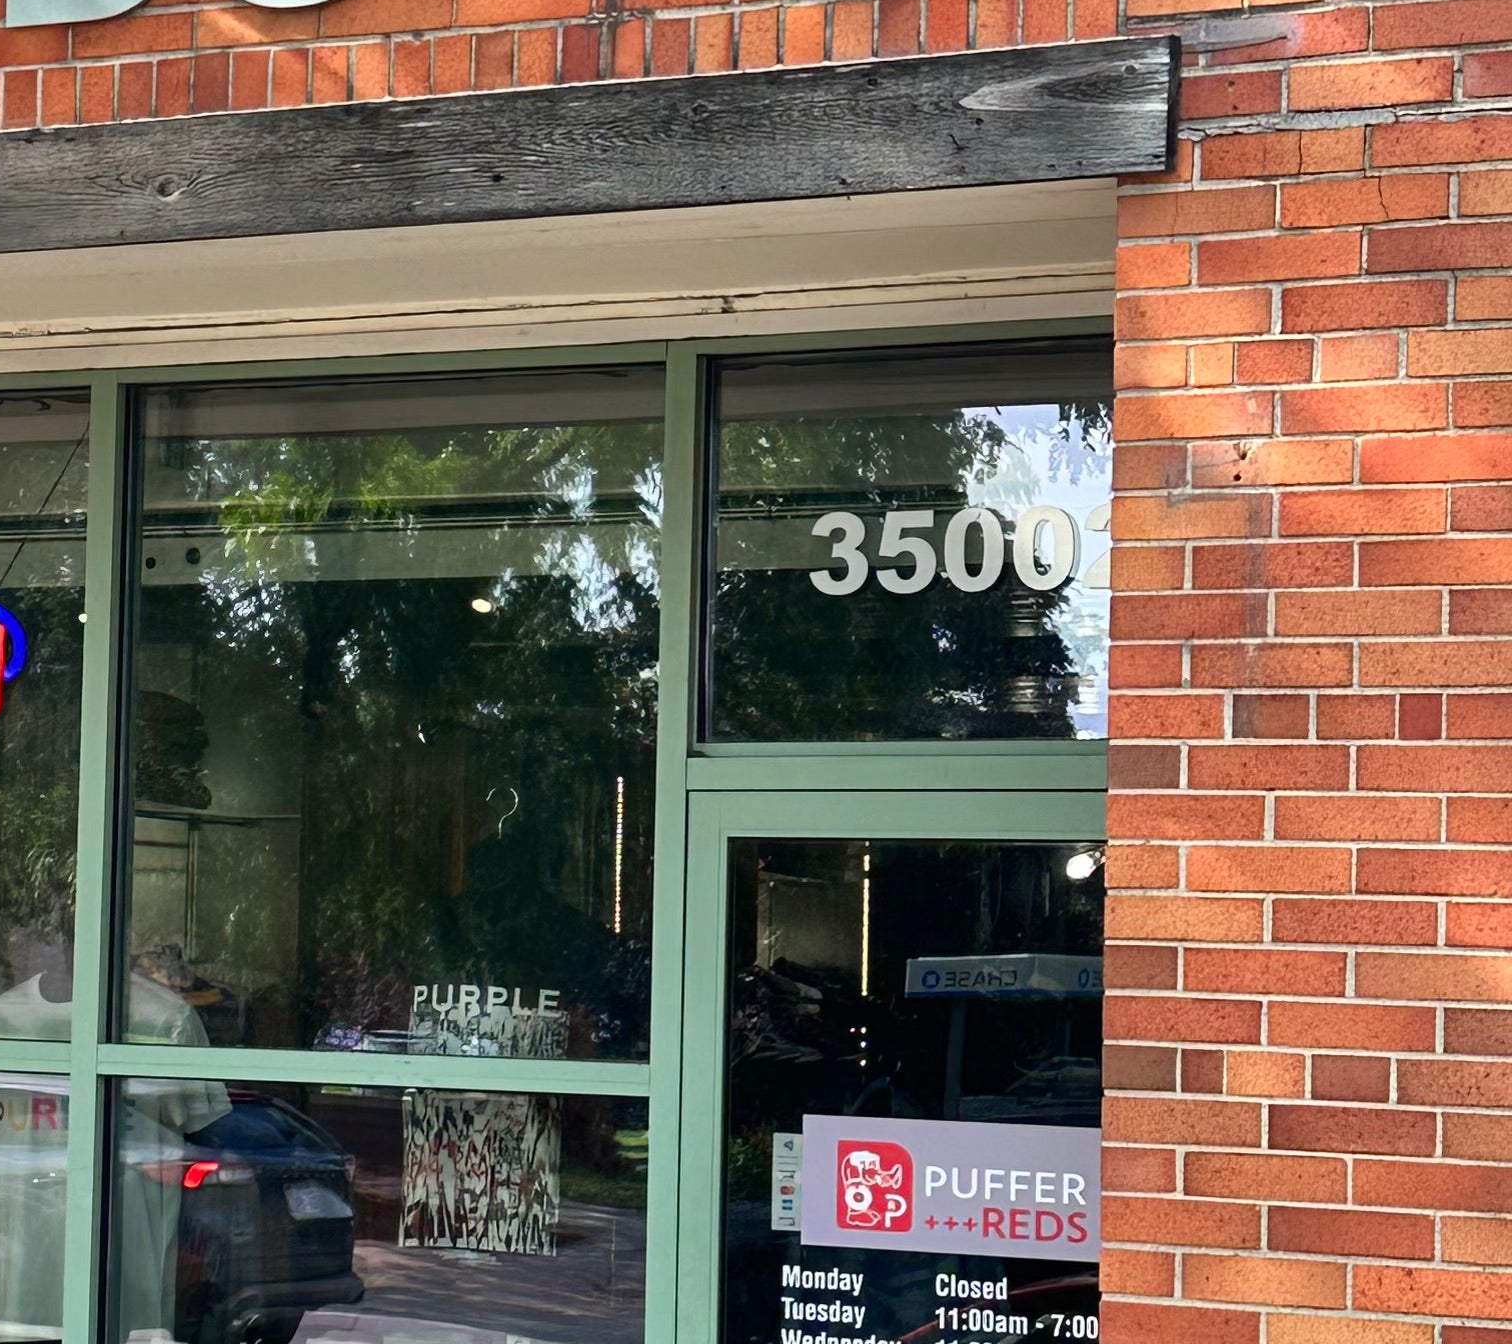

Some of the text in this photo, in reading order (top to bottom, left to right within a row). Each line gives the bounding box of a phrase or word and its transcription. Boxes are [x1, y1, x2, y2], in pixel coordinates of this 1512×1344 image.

[413, 983, 562, 1018] PURPLE
[924, 1165, 1087, 1206] PUFFER
[781, 1265, 1007, 1299] Monday Closed
[781, 1297, 865, 1328] Tuesday
[935, 1307, 1028, 1334] 11:00am
